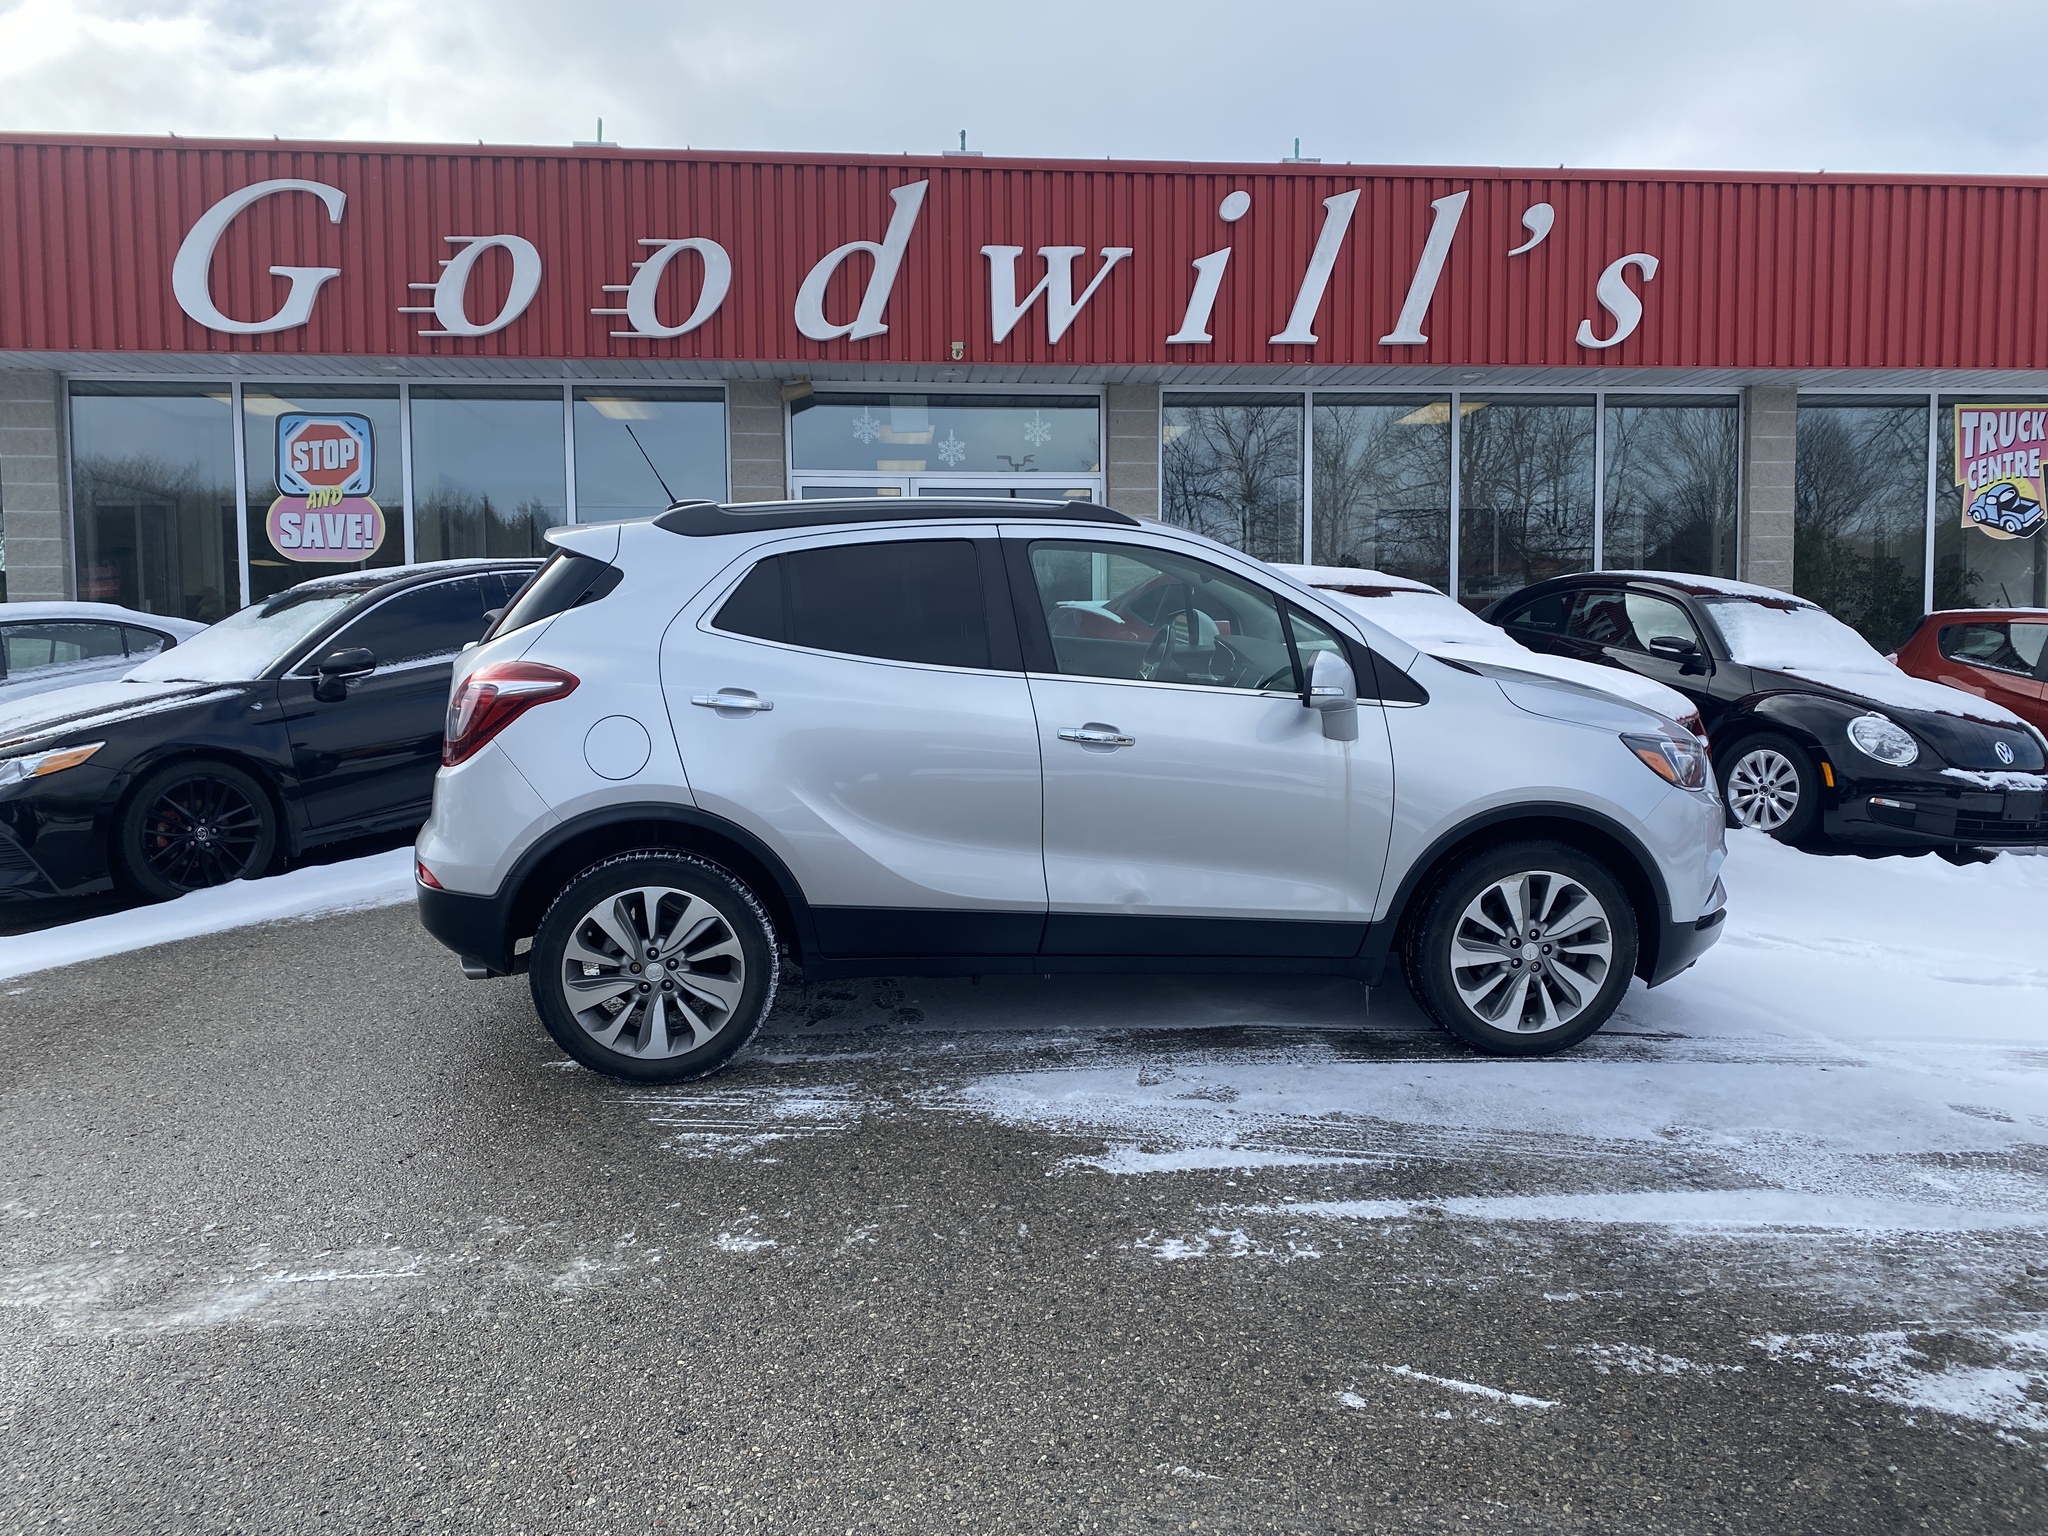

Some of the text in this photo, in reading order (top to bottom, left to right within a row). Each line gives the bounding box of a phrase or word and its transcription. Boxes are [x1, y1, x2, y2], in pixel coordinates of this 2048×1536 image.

[172, 178, 1660, 350] Goodwill's
[1961, 410, 2047, 459] TRUCK
[293, 438, 355, 472] STOP
[1967, 448, 2041, 491] CENTRE
[306, 486, 344, 510] AND
[279, 512, 375, 549] SAVE!
